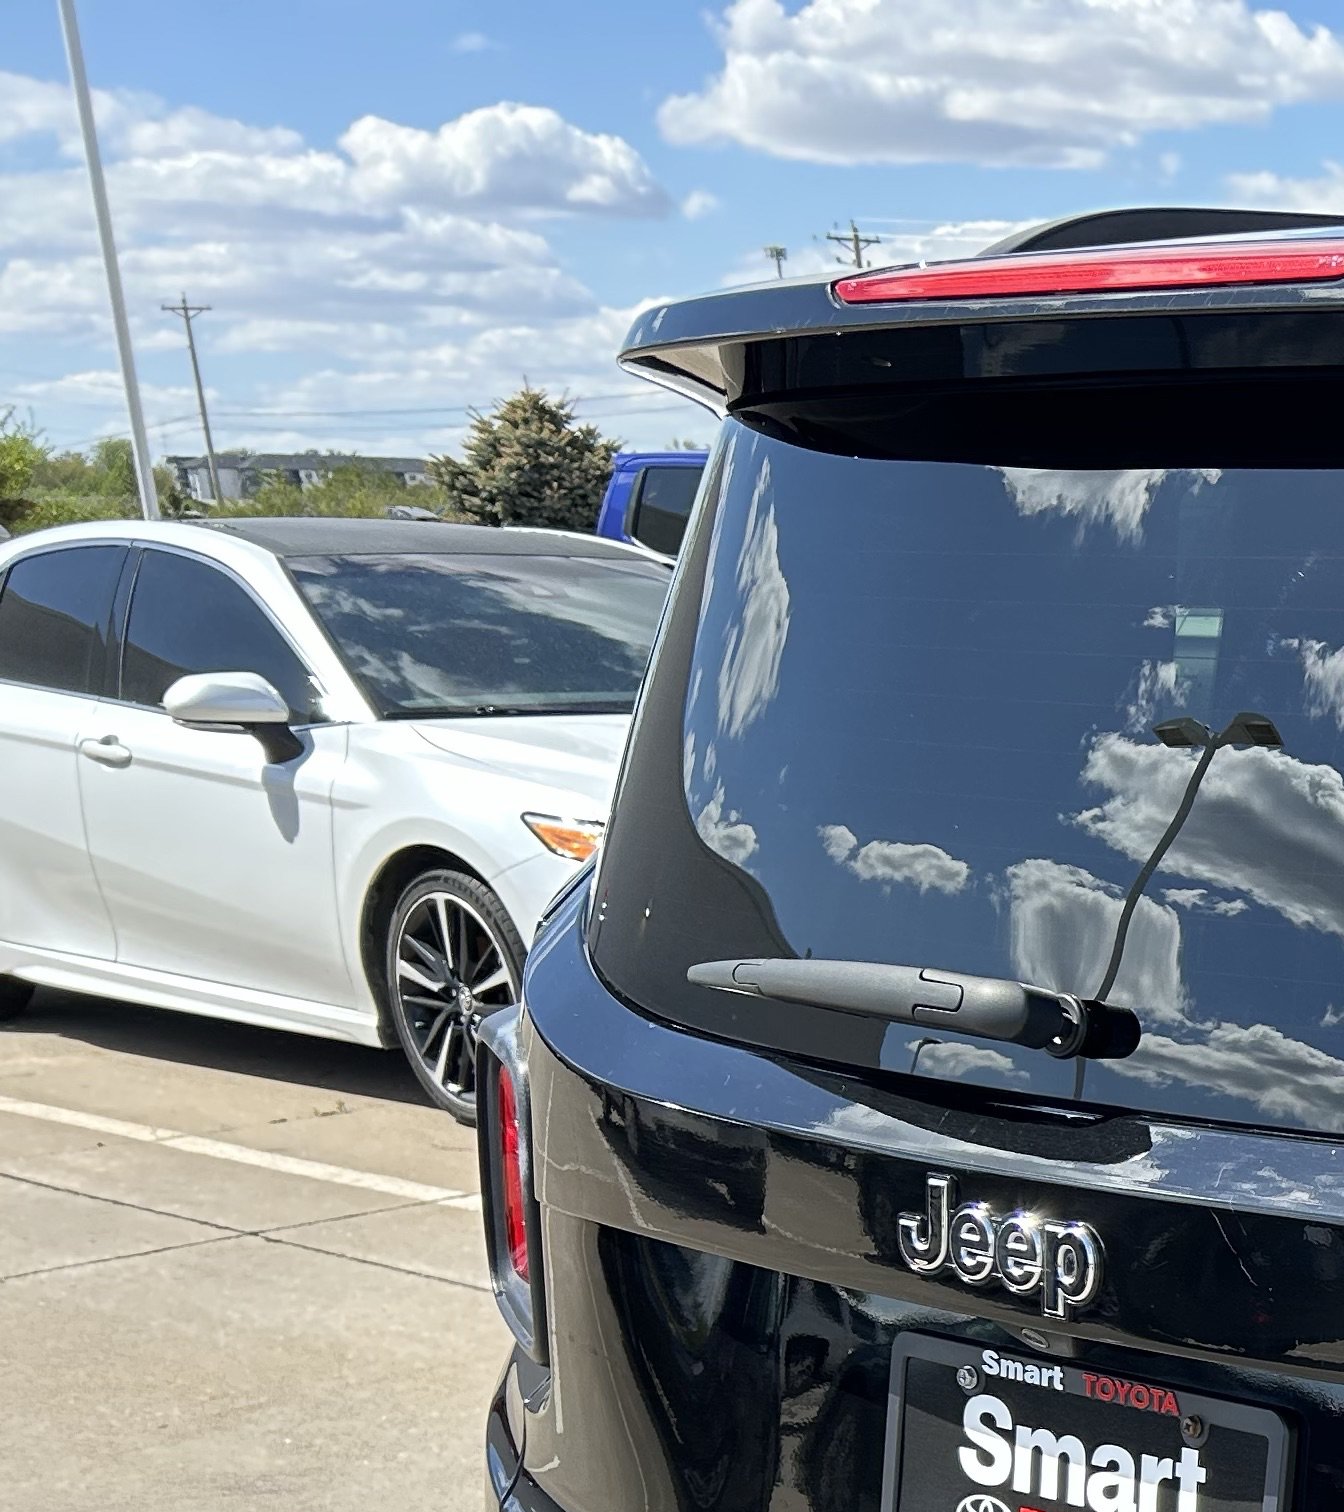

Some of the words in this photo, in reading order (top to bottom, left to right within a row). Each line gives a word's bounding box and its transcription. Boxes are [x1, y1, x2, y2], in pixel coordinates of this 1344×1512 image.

[898, 1171, 1105, 1322] Jeep
[981, 1349, 1064, 1391] Smart
[1082, 1371, 1180, 1417] TOYOTA
